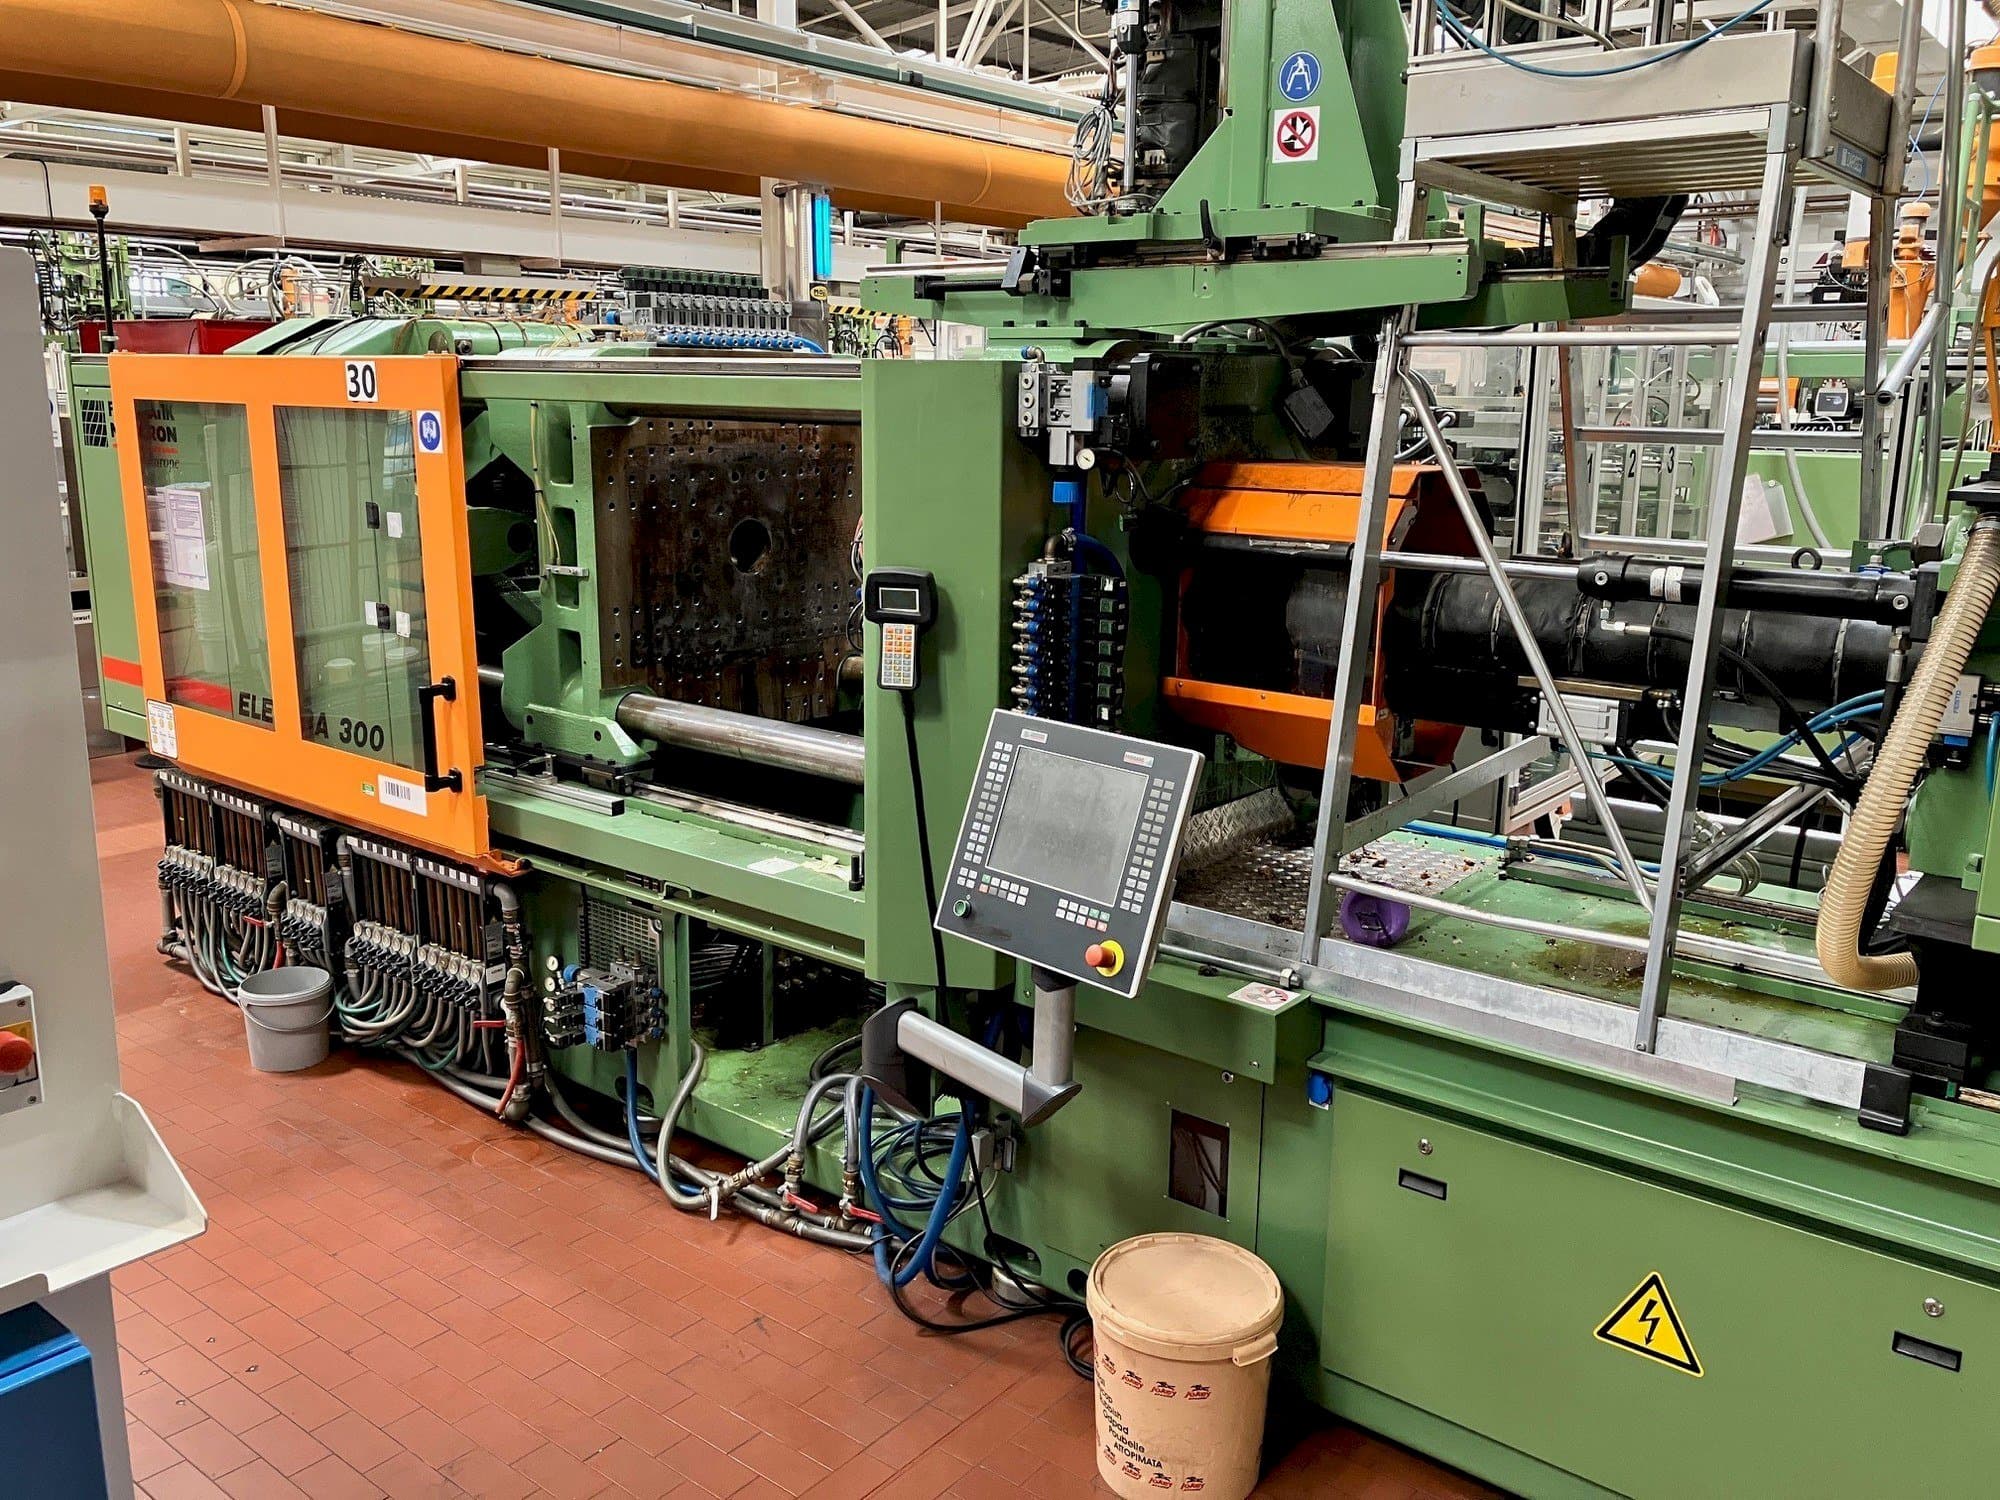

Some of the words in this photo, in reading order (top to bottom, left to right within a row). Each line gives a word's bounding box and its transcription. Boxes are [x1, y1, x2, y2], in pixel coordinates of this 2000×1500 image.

[347, 364, 375, 398] 30
[1587, 453, 1593, 483] 1
[1627, 449, 1636, 478] 2
[1667, 446, 1675, 473] 3
[339, 717, 385, 752] 300
[1109, 1424, 1145, 1454] Poubelle
